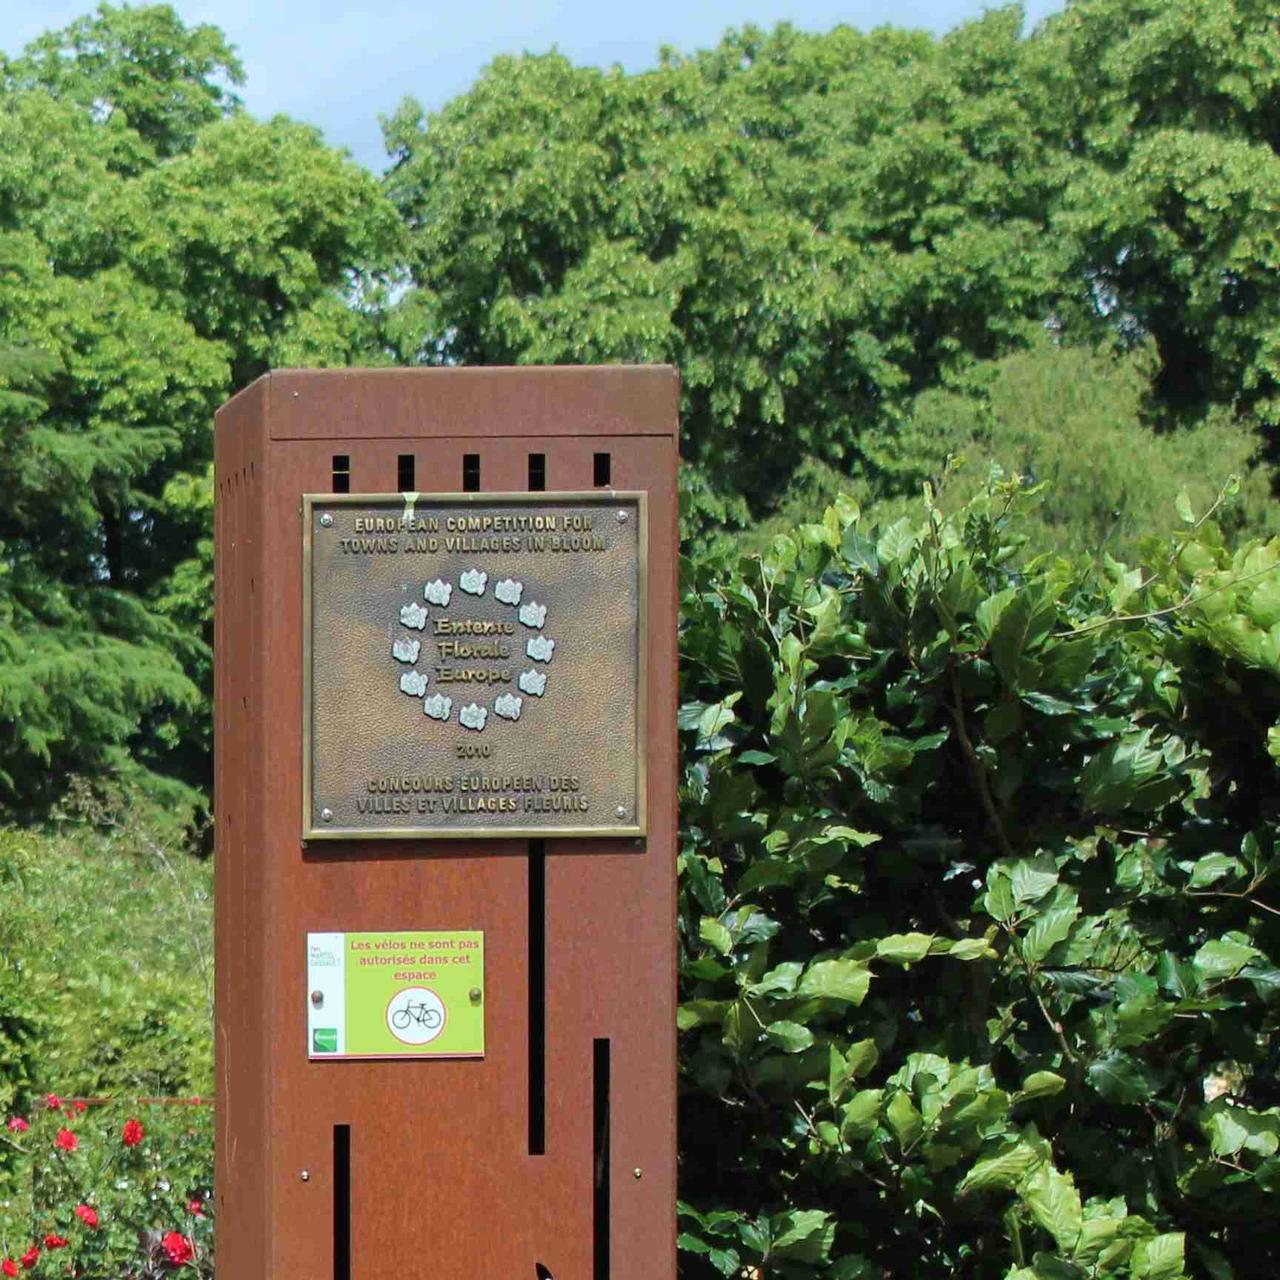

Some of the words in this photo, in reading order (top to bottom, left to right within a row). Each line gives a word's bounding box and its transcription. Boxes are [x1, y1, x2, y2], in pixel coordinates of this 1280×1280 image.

[355, 518, 439, 534] EUROPEAN
[447, 517, 557, 532] COMPETITION
[563, 516, 593, 532] FOR
[342, 538, 399, 553] TOWNS
[406, 537, 439, 553] AND
[445, 536, 521, 553] VILLAGES
[527, 536, 544, 552] IN
[551, 535, 606, 552] BLOOM
[433, 617, 514, 636] Entente
[437, 640, 510, 661] Florale
[436, 666, 512, 685] Europe
[457, 744, 491, 758] 2010
[367, 777, 454, 794] CONCOURS
[549, 776, 580, 792] DES
[356, 797, 410, 813] VILLES
[417, 797, 437, 812] ET
[441, 796, 517, 812] VILLAGES
[523, 795, 590, 812] FLEURIS
[351, 941, 371, 950] Les
[375, 940, 406, 950] vélos
[409, 942, 424, 950] ne
[428, 940, 455, 950] sont
[459, 941, 479, 952] pas
[360, 956, 416, 966] autorisés
[420, 955, 448, 965] dans
[452, 955, 471, 965] cet
[394, 971, 437, 981] espace
